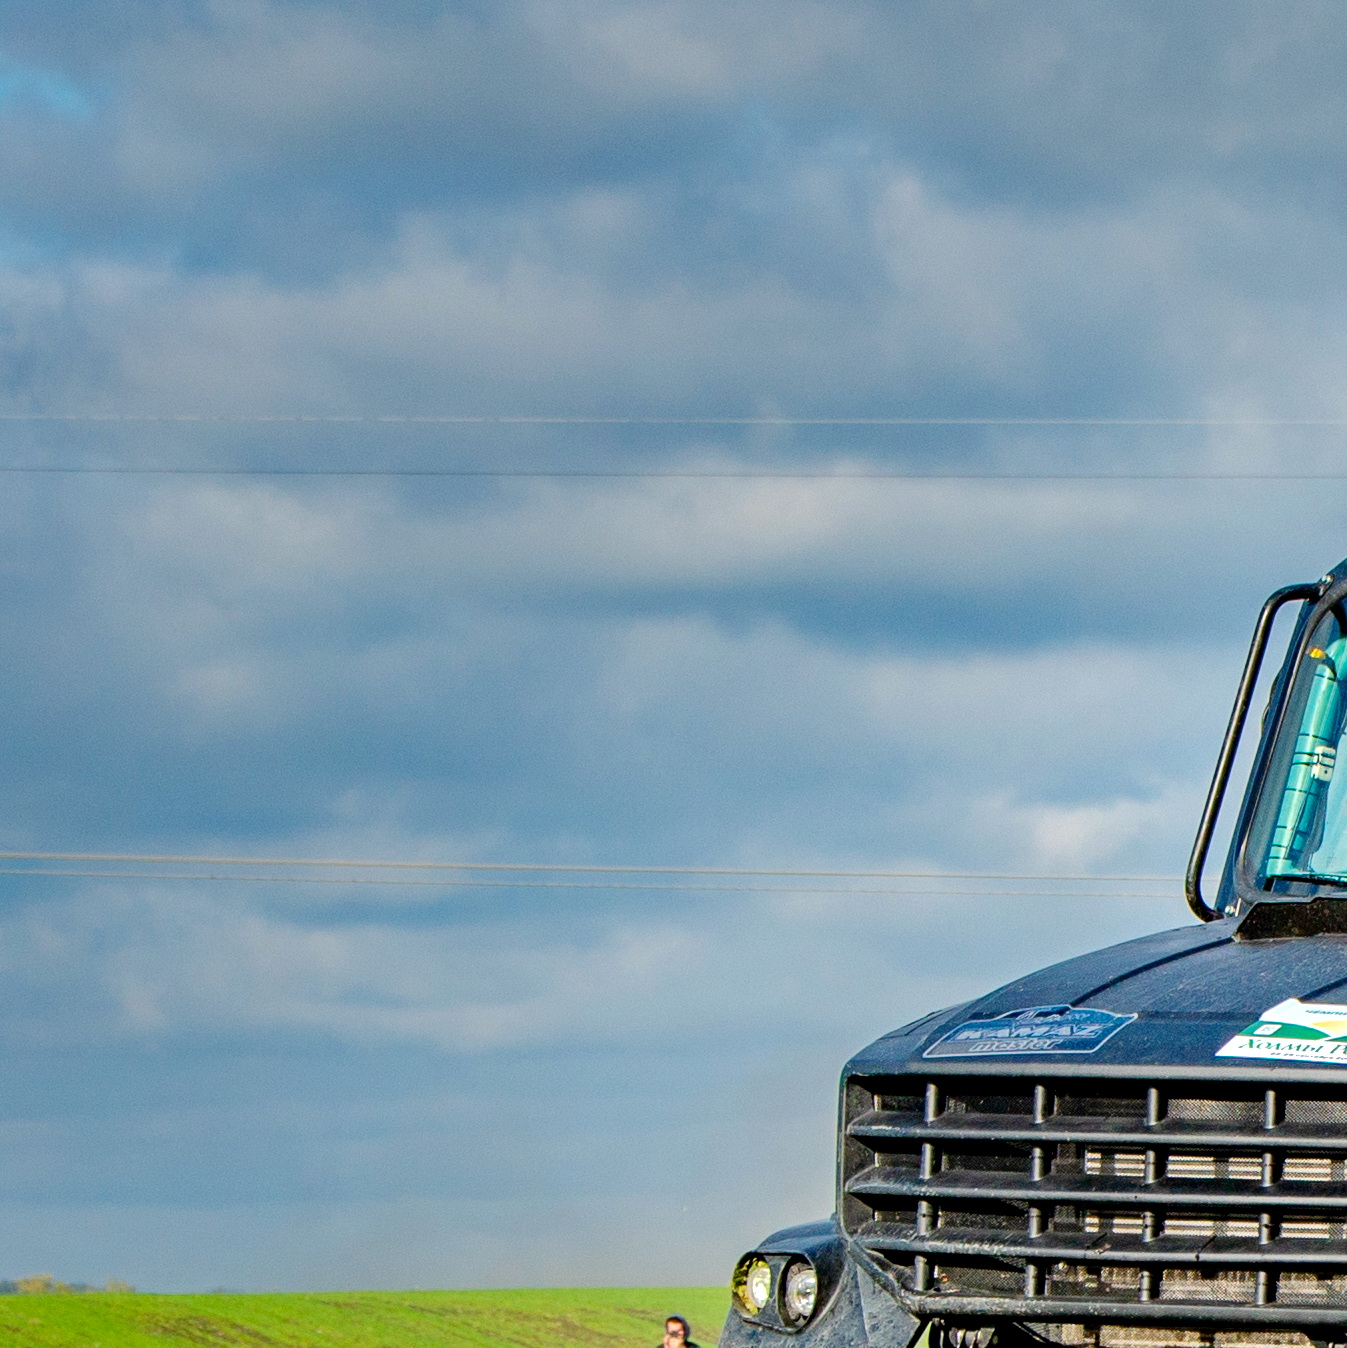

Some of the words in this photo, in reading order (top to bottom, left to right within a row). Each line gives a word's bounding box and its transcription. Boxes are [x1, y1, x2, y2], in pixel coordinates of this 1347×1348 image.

[955, 1025, 1102, 1040] KAMAZ
[969, 1039, 1063, 1052] master
[1238, 1038, 1324, 1053] Холмы
